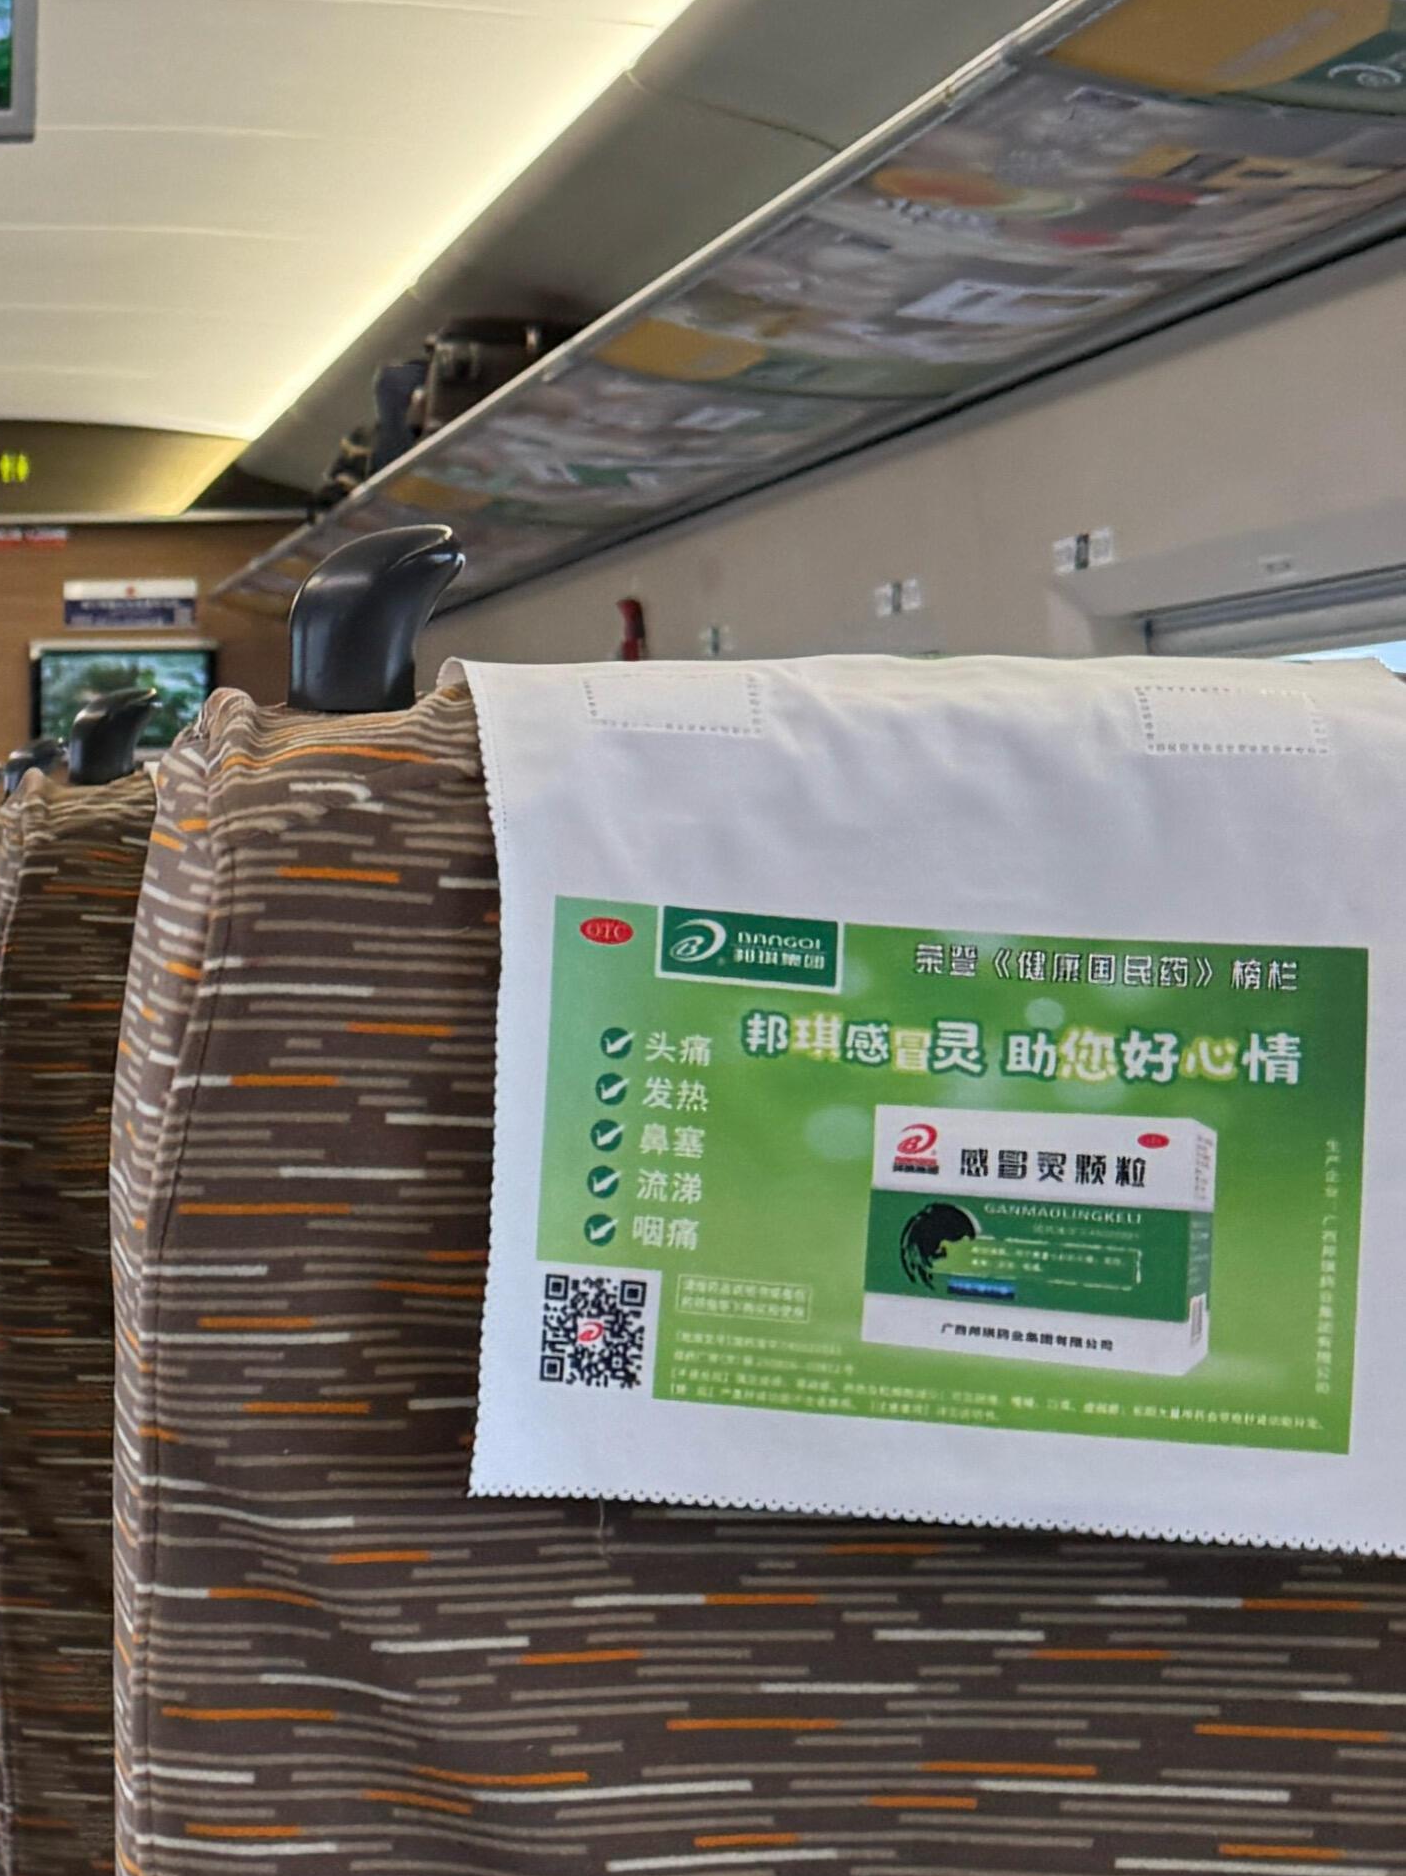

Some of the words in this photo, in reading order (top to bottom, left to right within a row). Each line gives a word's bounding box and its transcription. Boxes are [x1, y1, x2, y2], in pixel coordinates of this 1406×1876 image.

[644, 1031, 712, 1067] 头痛
[746, 1012, 984, 1075] 邦琪感冒灵
[1007, 1031, 1302, 1085] 助您好心情
[642, 1076, 709, 1112] 发热
